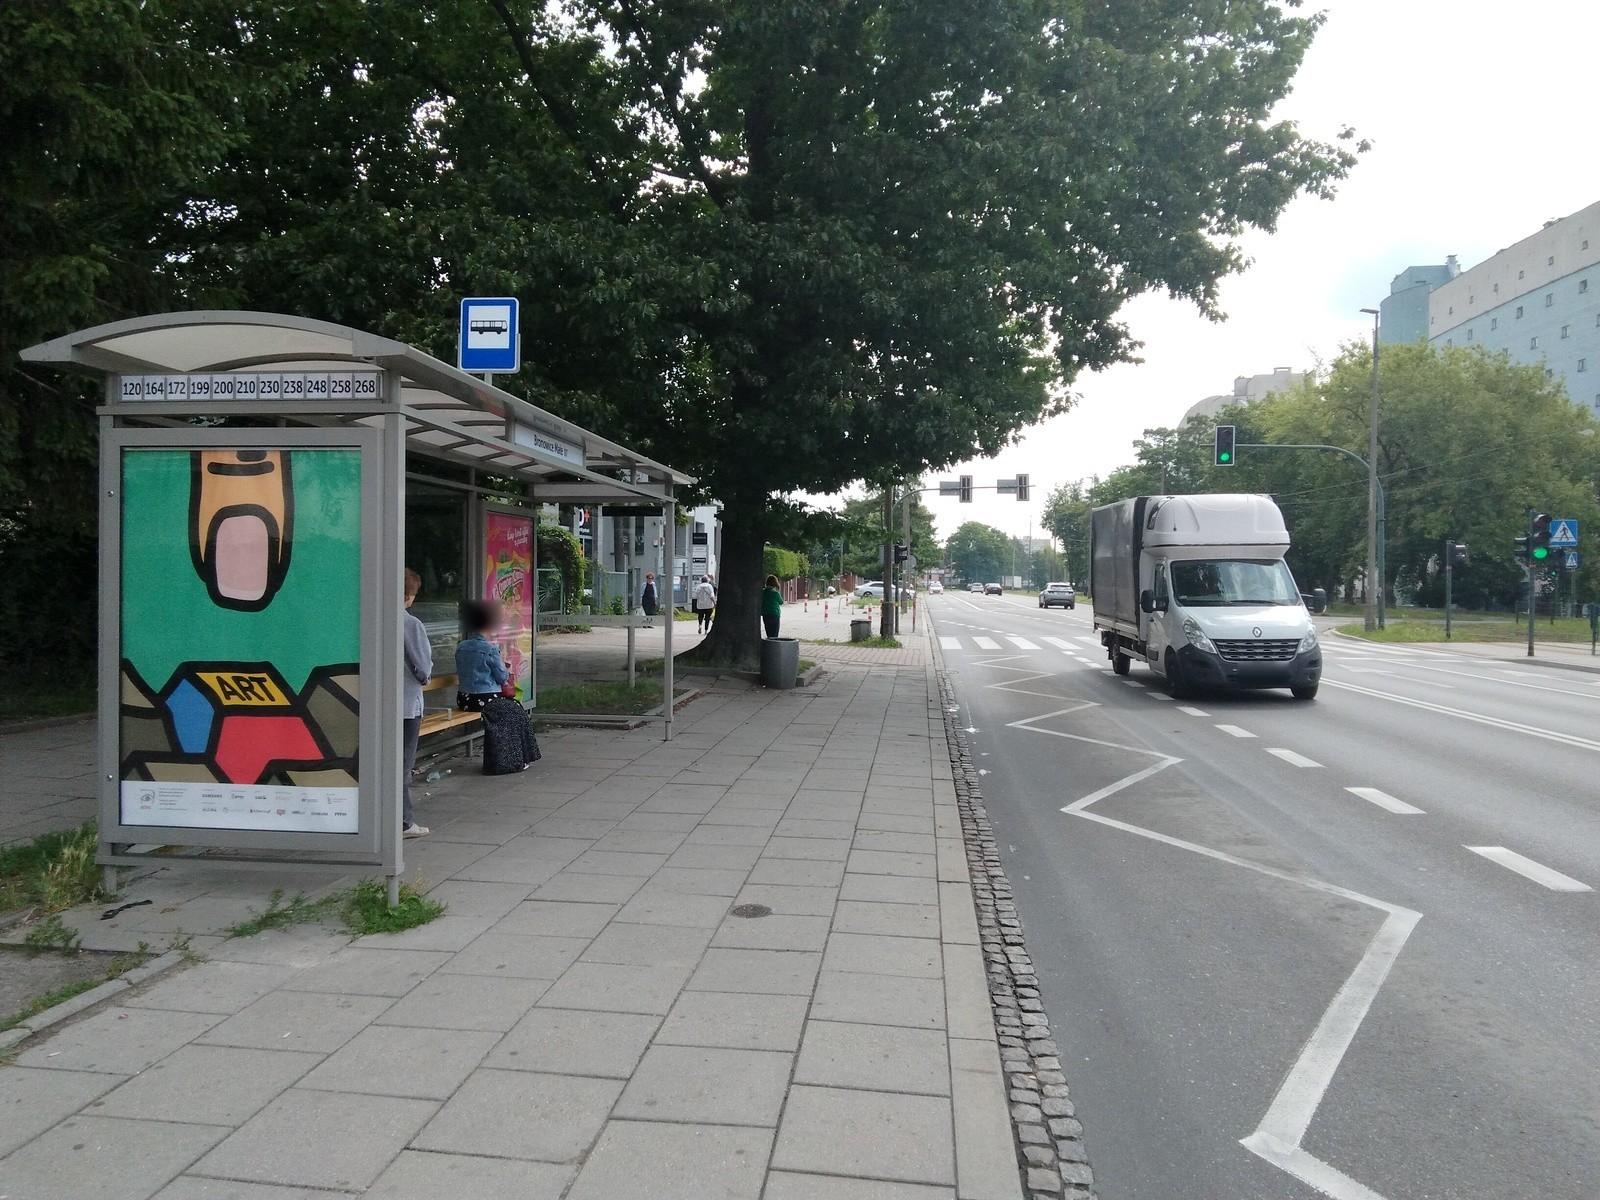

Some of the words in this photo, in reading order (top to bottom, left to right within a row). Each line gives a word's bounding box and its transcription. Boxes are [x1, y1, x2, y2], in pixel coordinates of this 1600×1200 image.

[123, 382, 142, 396] 120
[145, 382, 164, 396] 164
[168, 381, 185, 395] 172
[191, 381, 210, 395] 199
[214, 381, 233, 394] 200
[237, 381, 256, 394] 210
[260, 381, 279, 394] 230
[283, 380, 303, 394] 238
[307, 380, 327, 394] 248
[331, 380, 351, 393] 258
[355, 379, 375, 393] 268
[534, 434, 554, 452] Bronowice
[216, 675, 276, 702] ART
